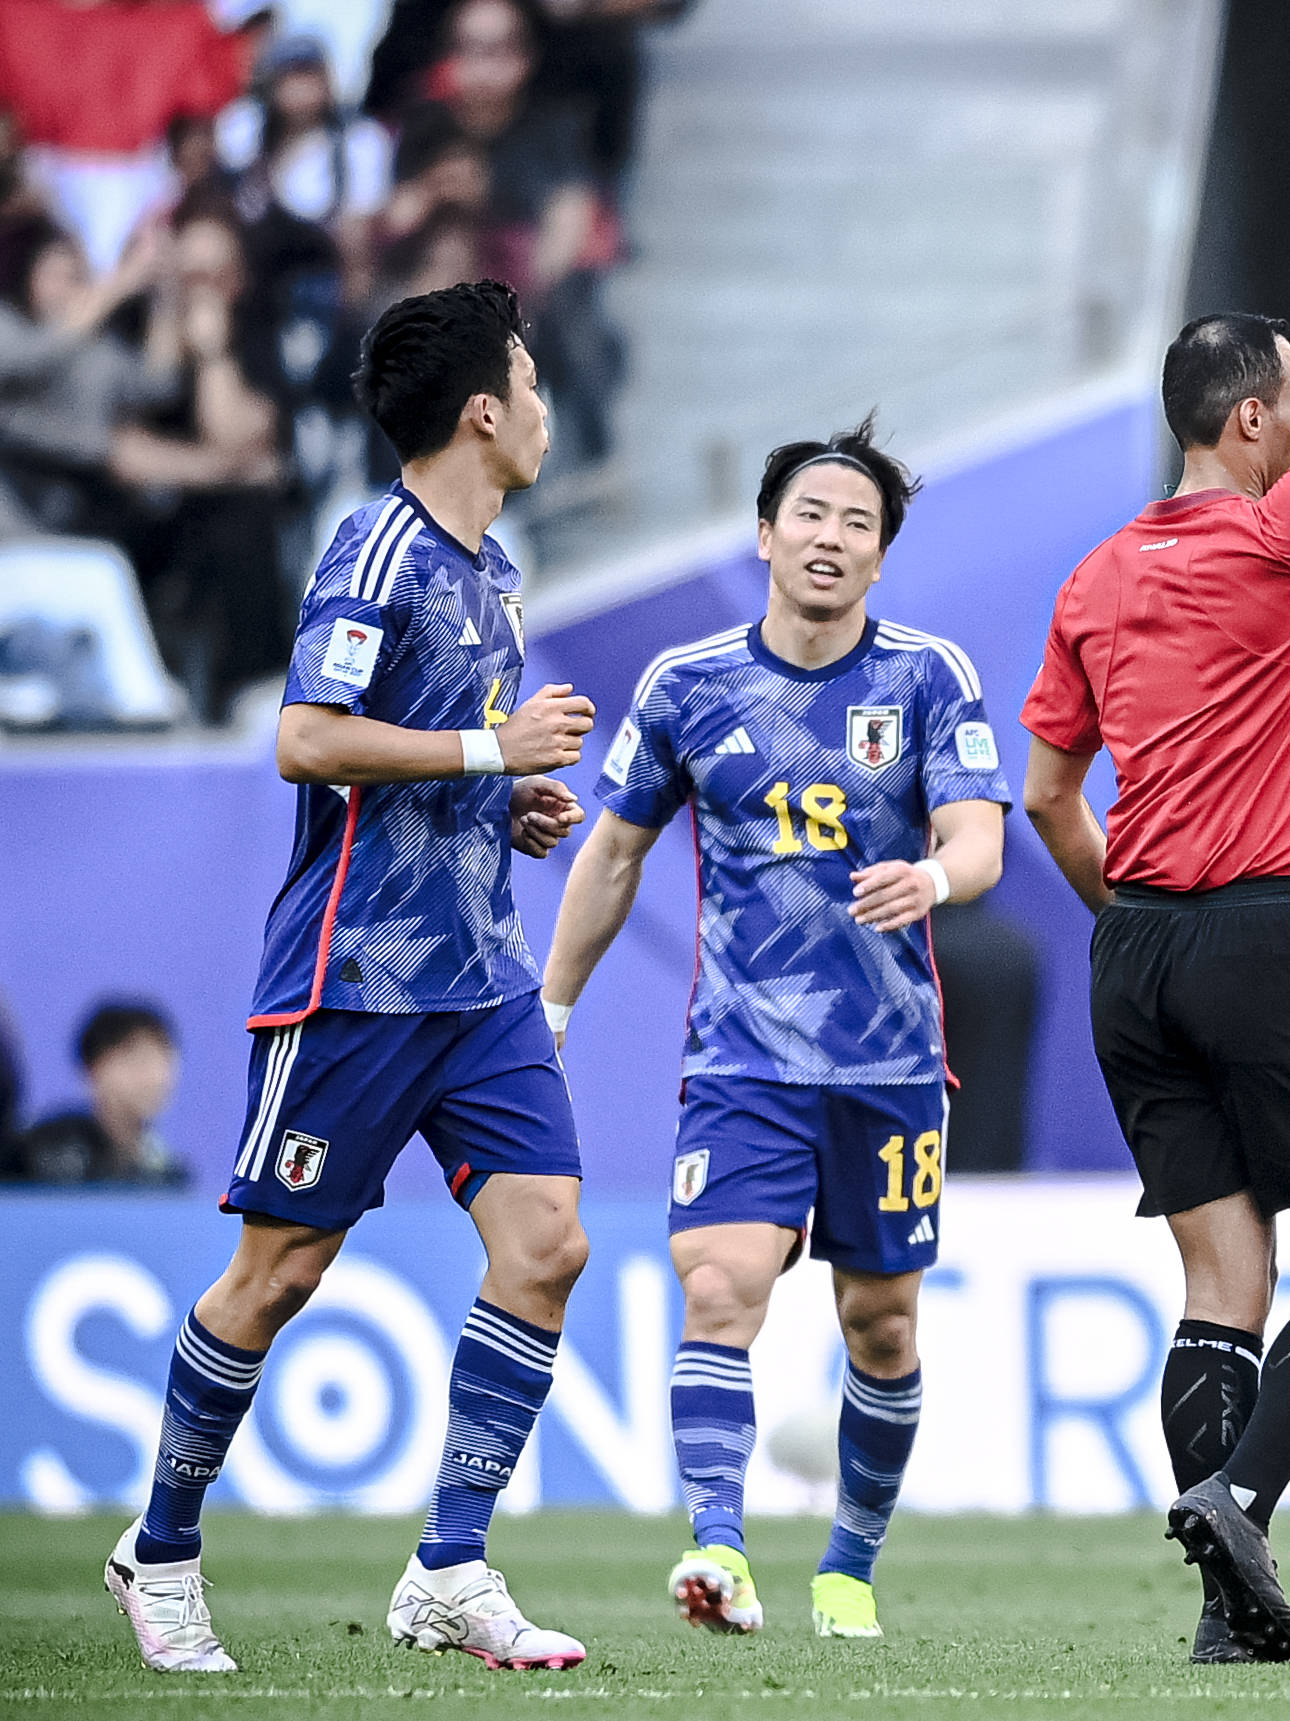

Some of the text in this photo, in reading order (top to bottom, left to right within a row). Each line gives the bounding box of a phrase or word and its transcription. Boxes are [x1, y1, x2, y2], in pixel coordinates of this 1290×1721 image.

[764, 781, 848, 854] 18
[878, 1129, 941, 1212] 18
[1172, 1338, 1233, 1353] ELME
[167, 1457, 221, 1477] JAPA
[453, 1453, 512, 1477] JAPA
